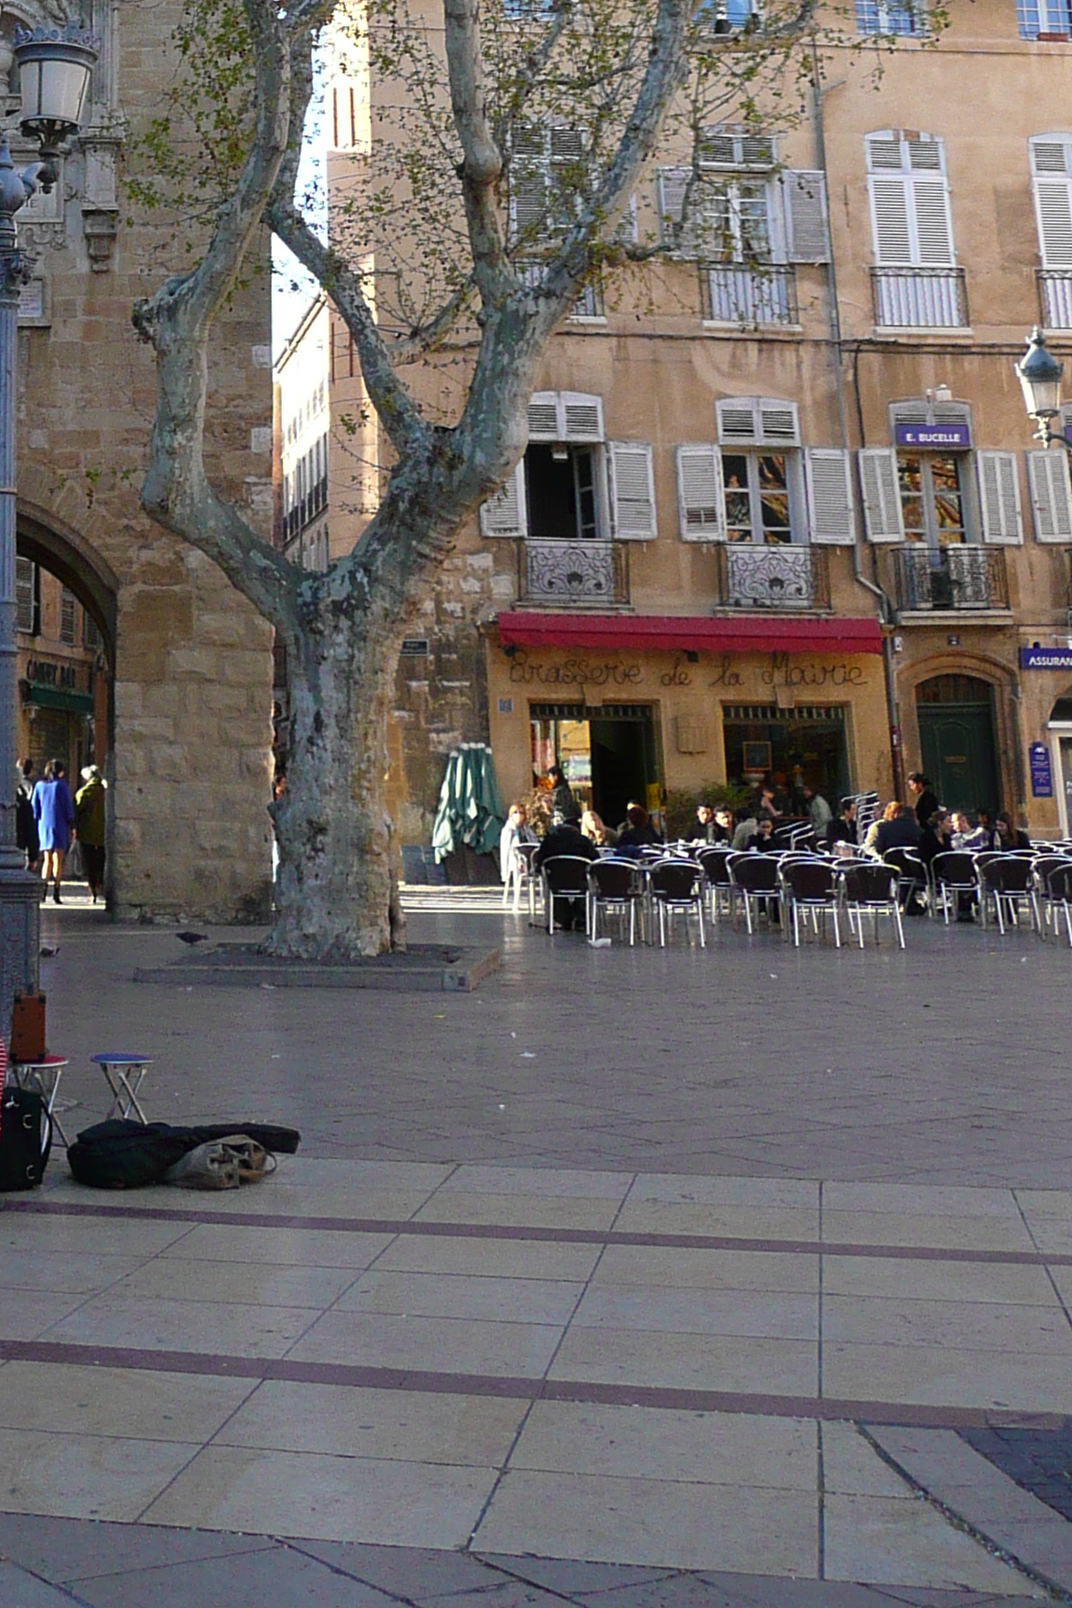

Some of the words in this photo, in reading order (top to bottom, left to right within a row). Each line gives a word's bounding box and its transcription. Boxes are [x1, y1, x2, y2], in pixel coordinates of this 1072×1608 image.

[508, 650, 643, 685] Brasserie
[660, 657, 693, 687] de
[707, 655, 746, 688] la
[761, 650, 869, 687] Mairie
